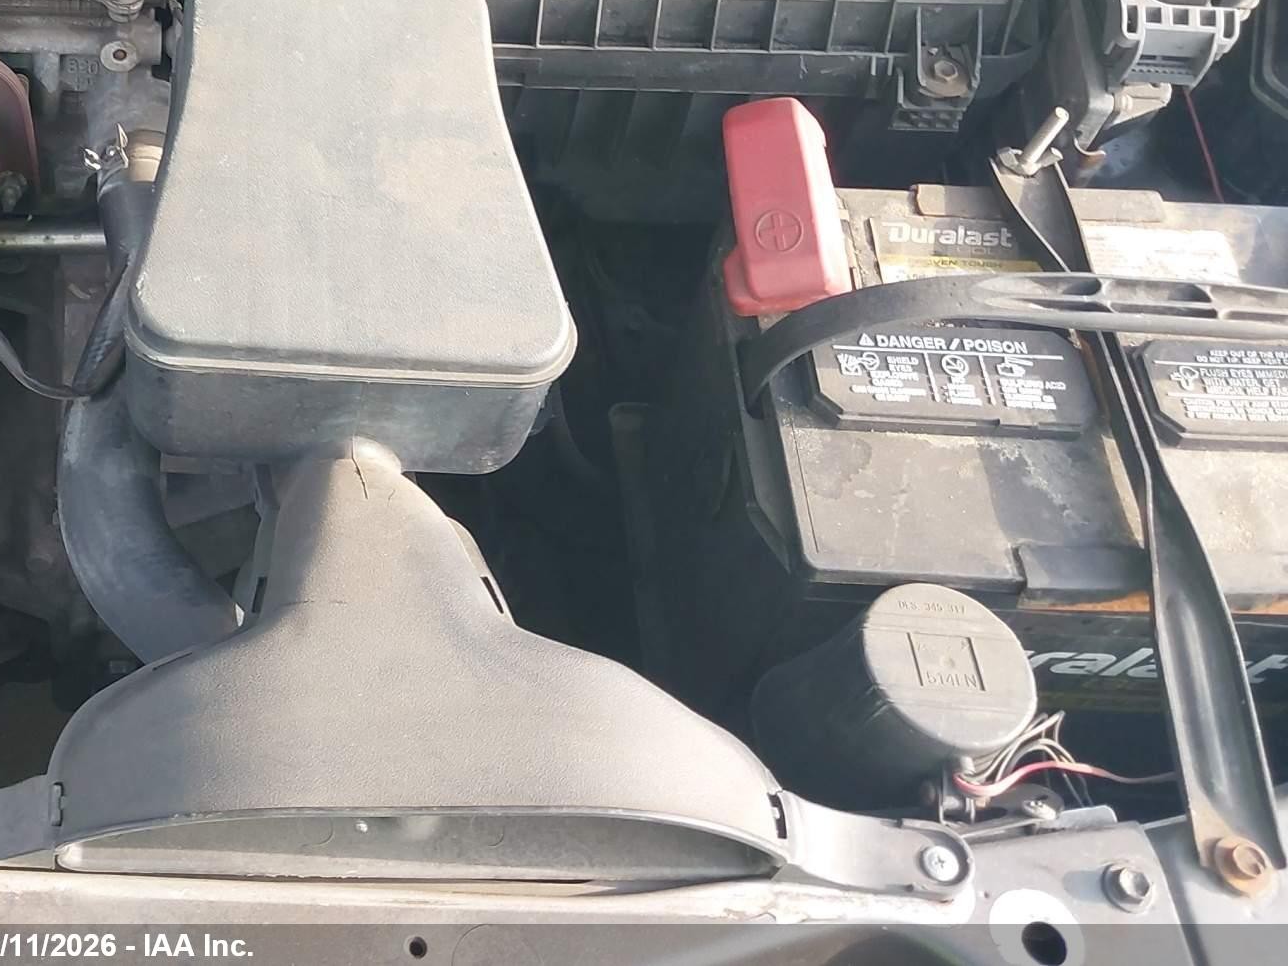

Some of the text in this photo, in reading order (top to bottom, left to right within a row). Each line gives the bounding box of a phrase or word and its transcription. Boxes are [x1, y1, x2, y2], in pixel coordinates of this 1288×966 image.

[881, 221, 1013, 248] Duralast
[876, 334, 946, 350] DANGER
[963, 338, 1028, 355] POISON
[886, 356, 919, 366] SHIELD
[1199, 368, 1229, 378] FLUSH
[1229, 368, 1254, 379] EYES
[1203, 377, 1227, 387] WITH
[1262, 379, 1281, 388] GET
